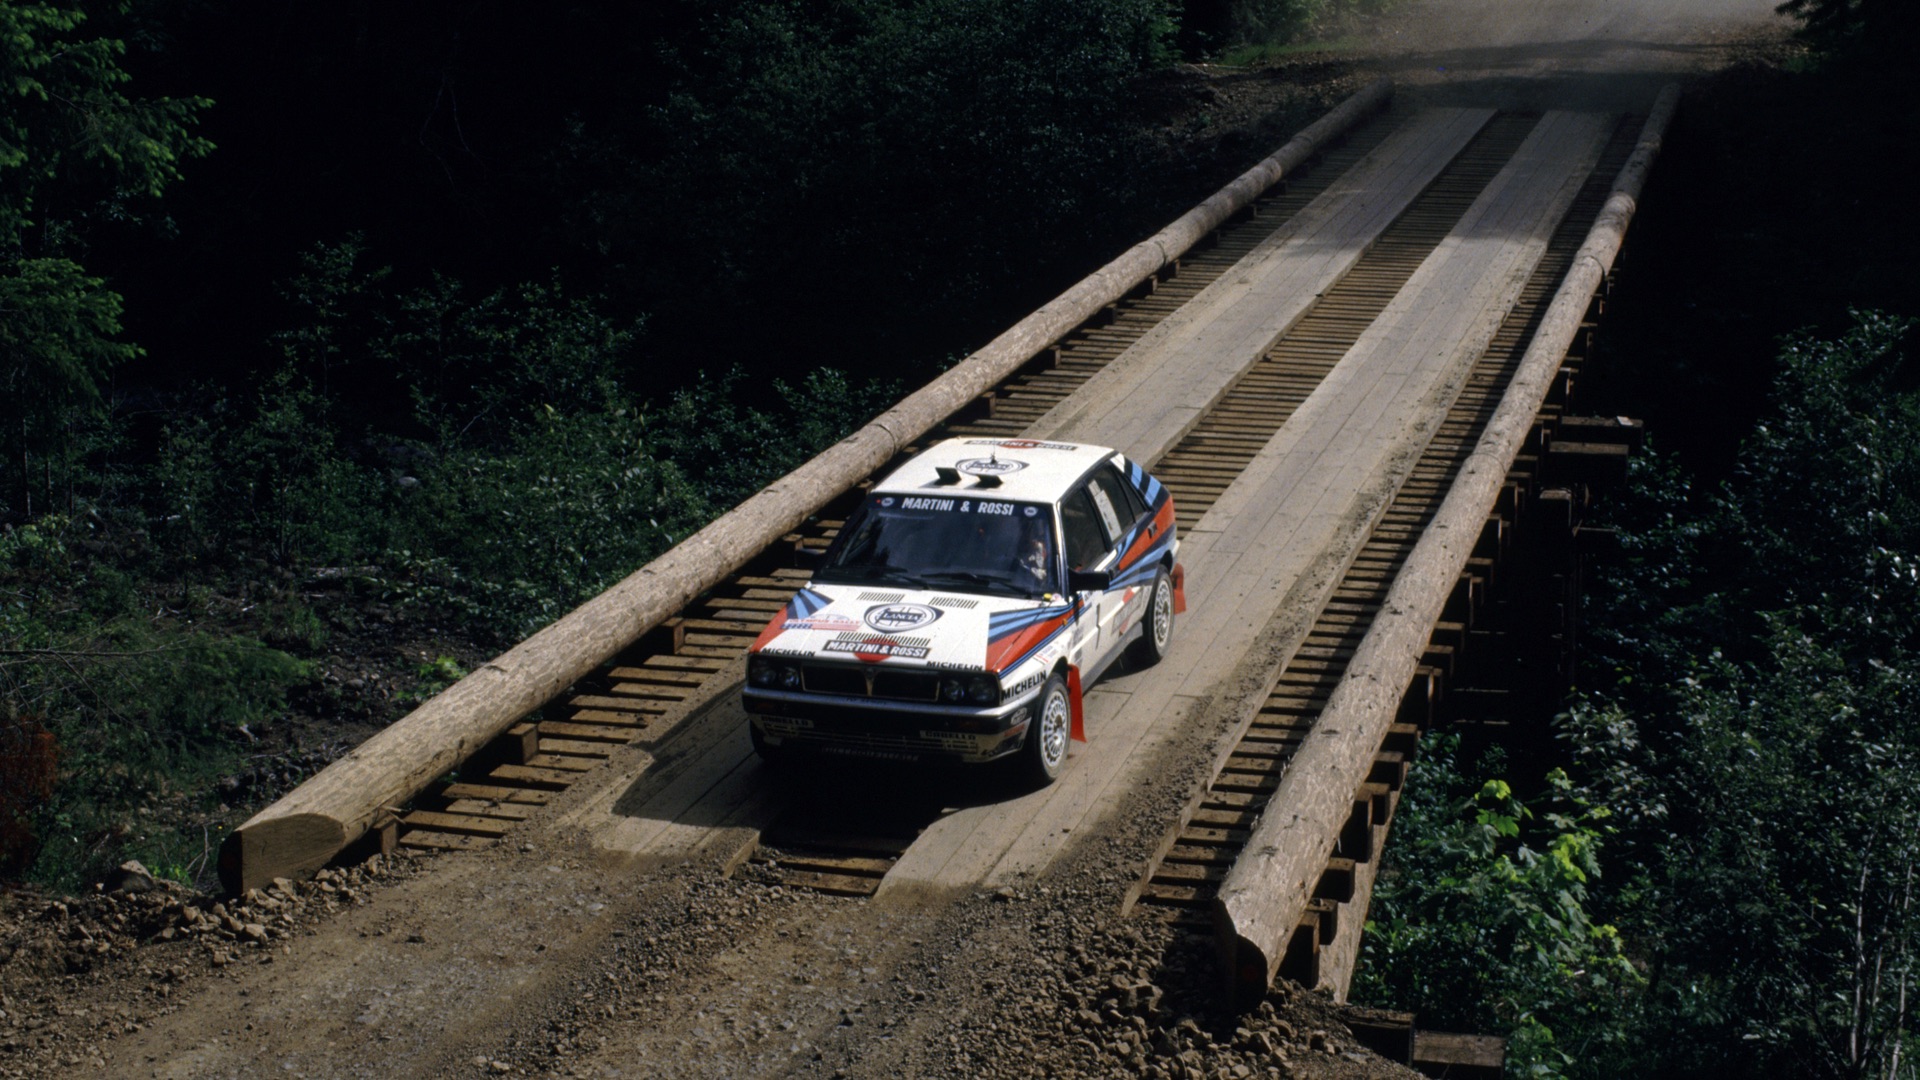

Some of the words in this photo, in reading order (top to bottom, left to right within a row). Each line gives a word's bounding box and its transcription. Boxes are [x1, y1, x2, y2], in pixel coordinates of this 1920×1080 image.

[901, 497, 954, 511] MARTINI
[960, 500, 970, 512] &
[978, 501, 1014, 516] ROSSI
[883, 611, 919, 621] LANCIA
[762, 647, 815, 657] MICHELIN
[826, 641, 879, 654] MARTINI
[879, 645, 890, 655] &
[890, 647, 927, 657] ROSSI
[926, 660, 983, 671] MICHELIN
[1001, 670, 1047, 701] MICHELIN
